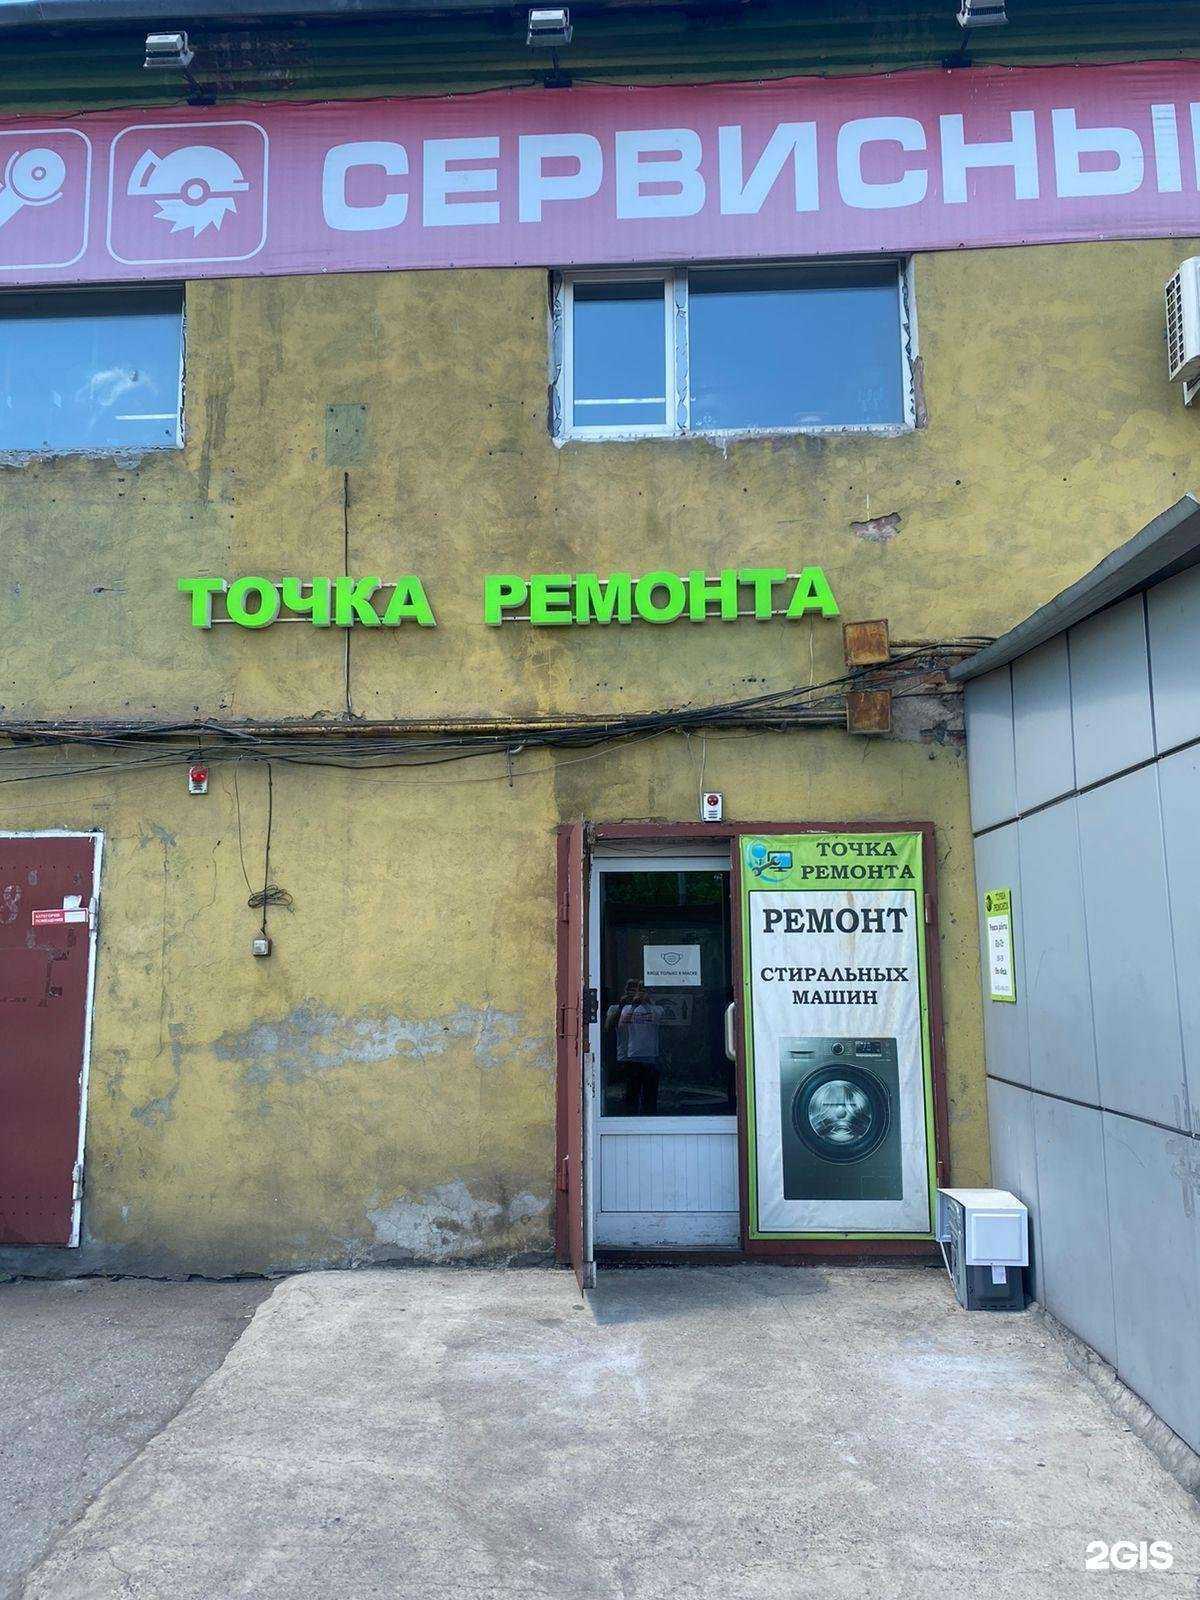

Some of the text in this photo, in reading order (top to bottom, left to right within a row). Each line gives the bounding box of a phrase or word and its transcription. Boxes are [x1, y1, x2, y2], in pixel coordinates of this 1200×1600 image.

[177, 566, 840, 630] ТОЧКА РЕМОНТА
[816, 842, 898, 857] ТОЧКА
[801, 864, 915, 880] РЕМОНТА
[762, 907, 908, 934] РЕМОНТ
[761, 967, 909, 982] СТИРАЛЬНЫХ
[792, 990, 878, 1005] МАШИН
